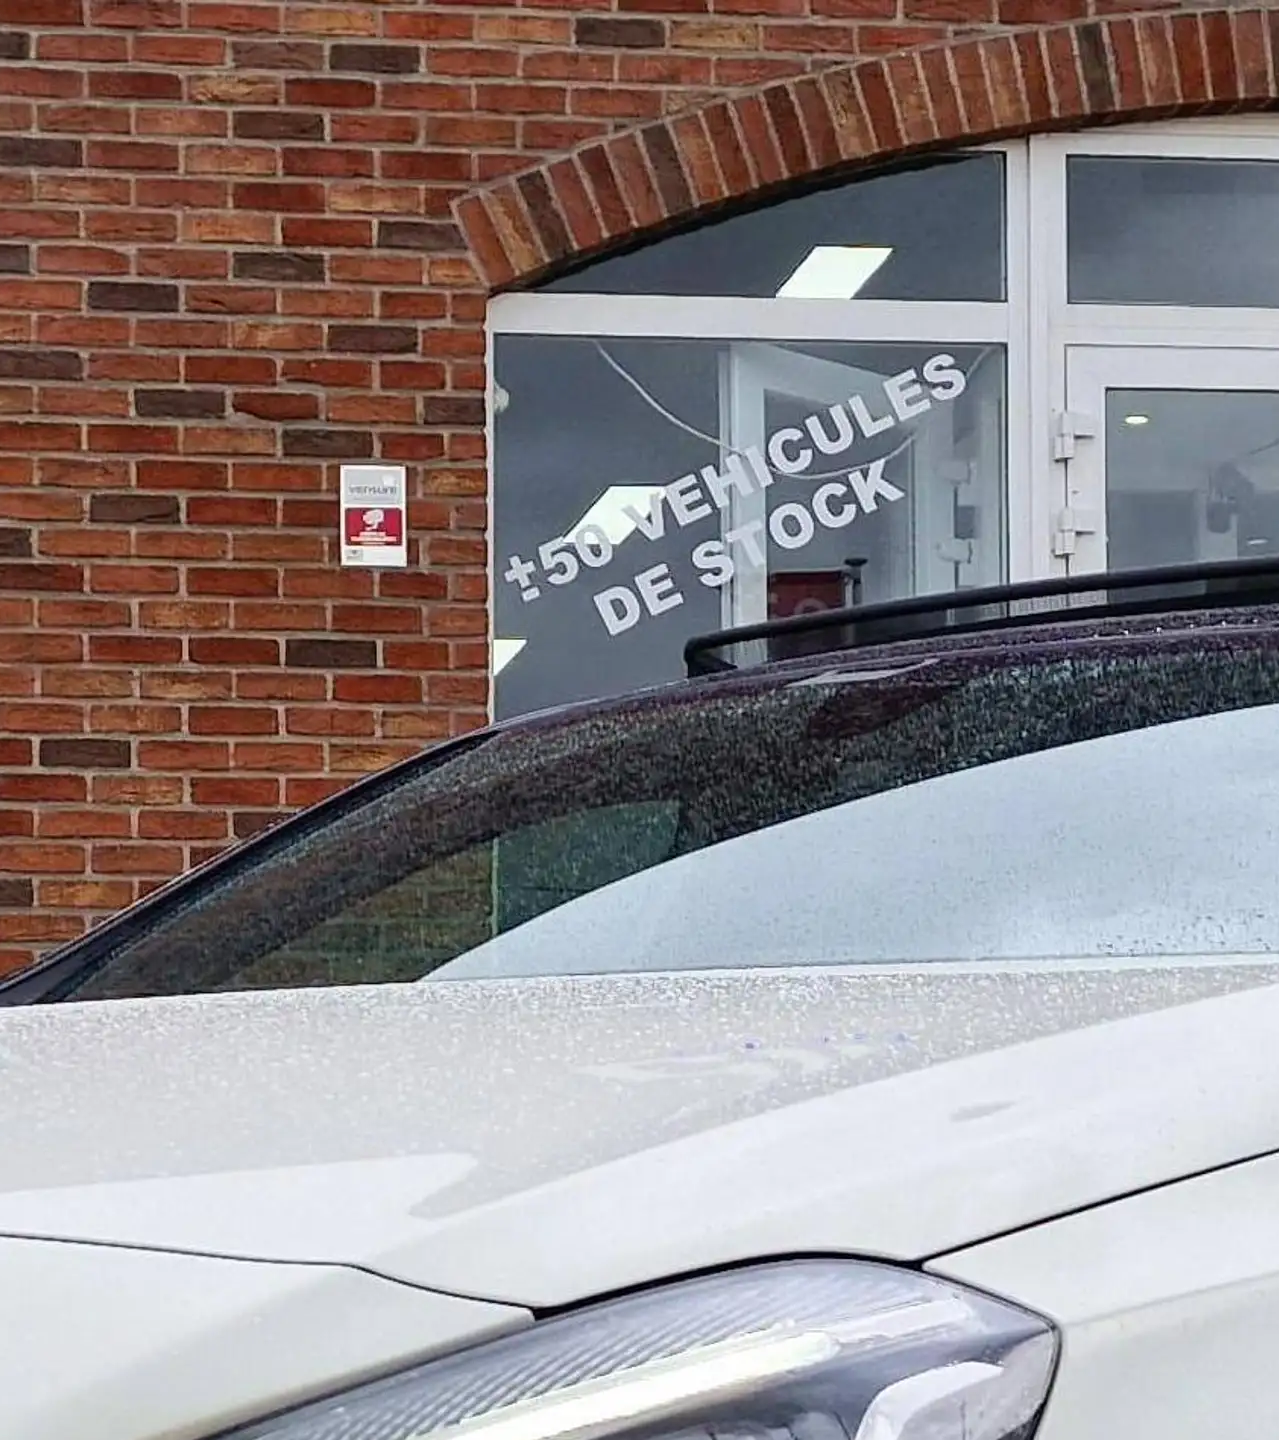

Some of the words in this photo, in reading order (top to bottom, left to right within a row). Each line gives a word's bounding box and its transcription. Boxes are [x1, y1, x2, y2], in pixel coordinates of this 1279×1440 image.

[622, 352, 967, 542] VEHICULES
[593, 562, 684, 637] DE
[691, 458, 906, 589] STOCK
